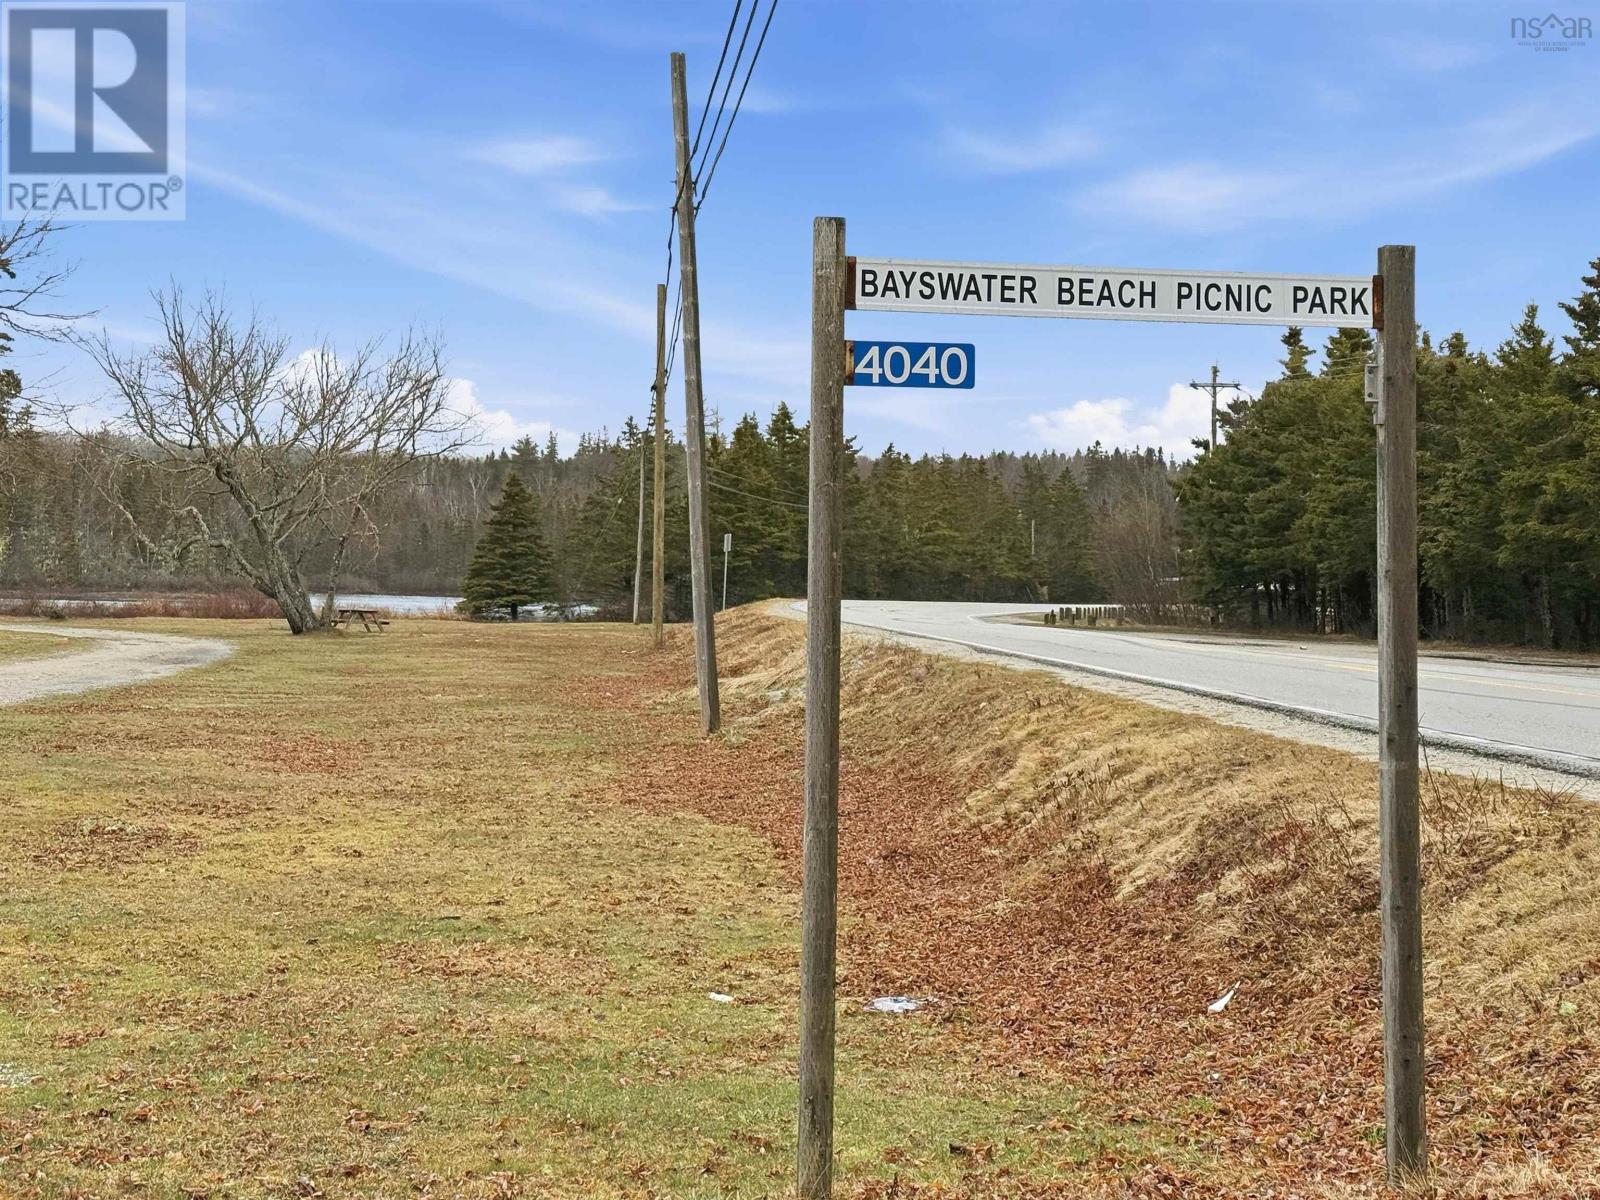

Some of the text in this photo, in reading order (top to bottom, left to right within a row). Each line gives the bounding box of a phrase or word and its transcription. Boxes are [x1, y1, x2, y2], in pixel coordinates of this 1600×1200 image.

[861, 269, 1369, 316] BAYSWATER BEACH PICNIC PARK
[854, 345, 968, 385] 4040
